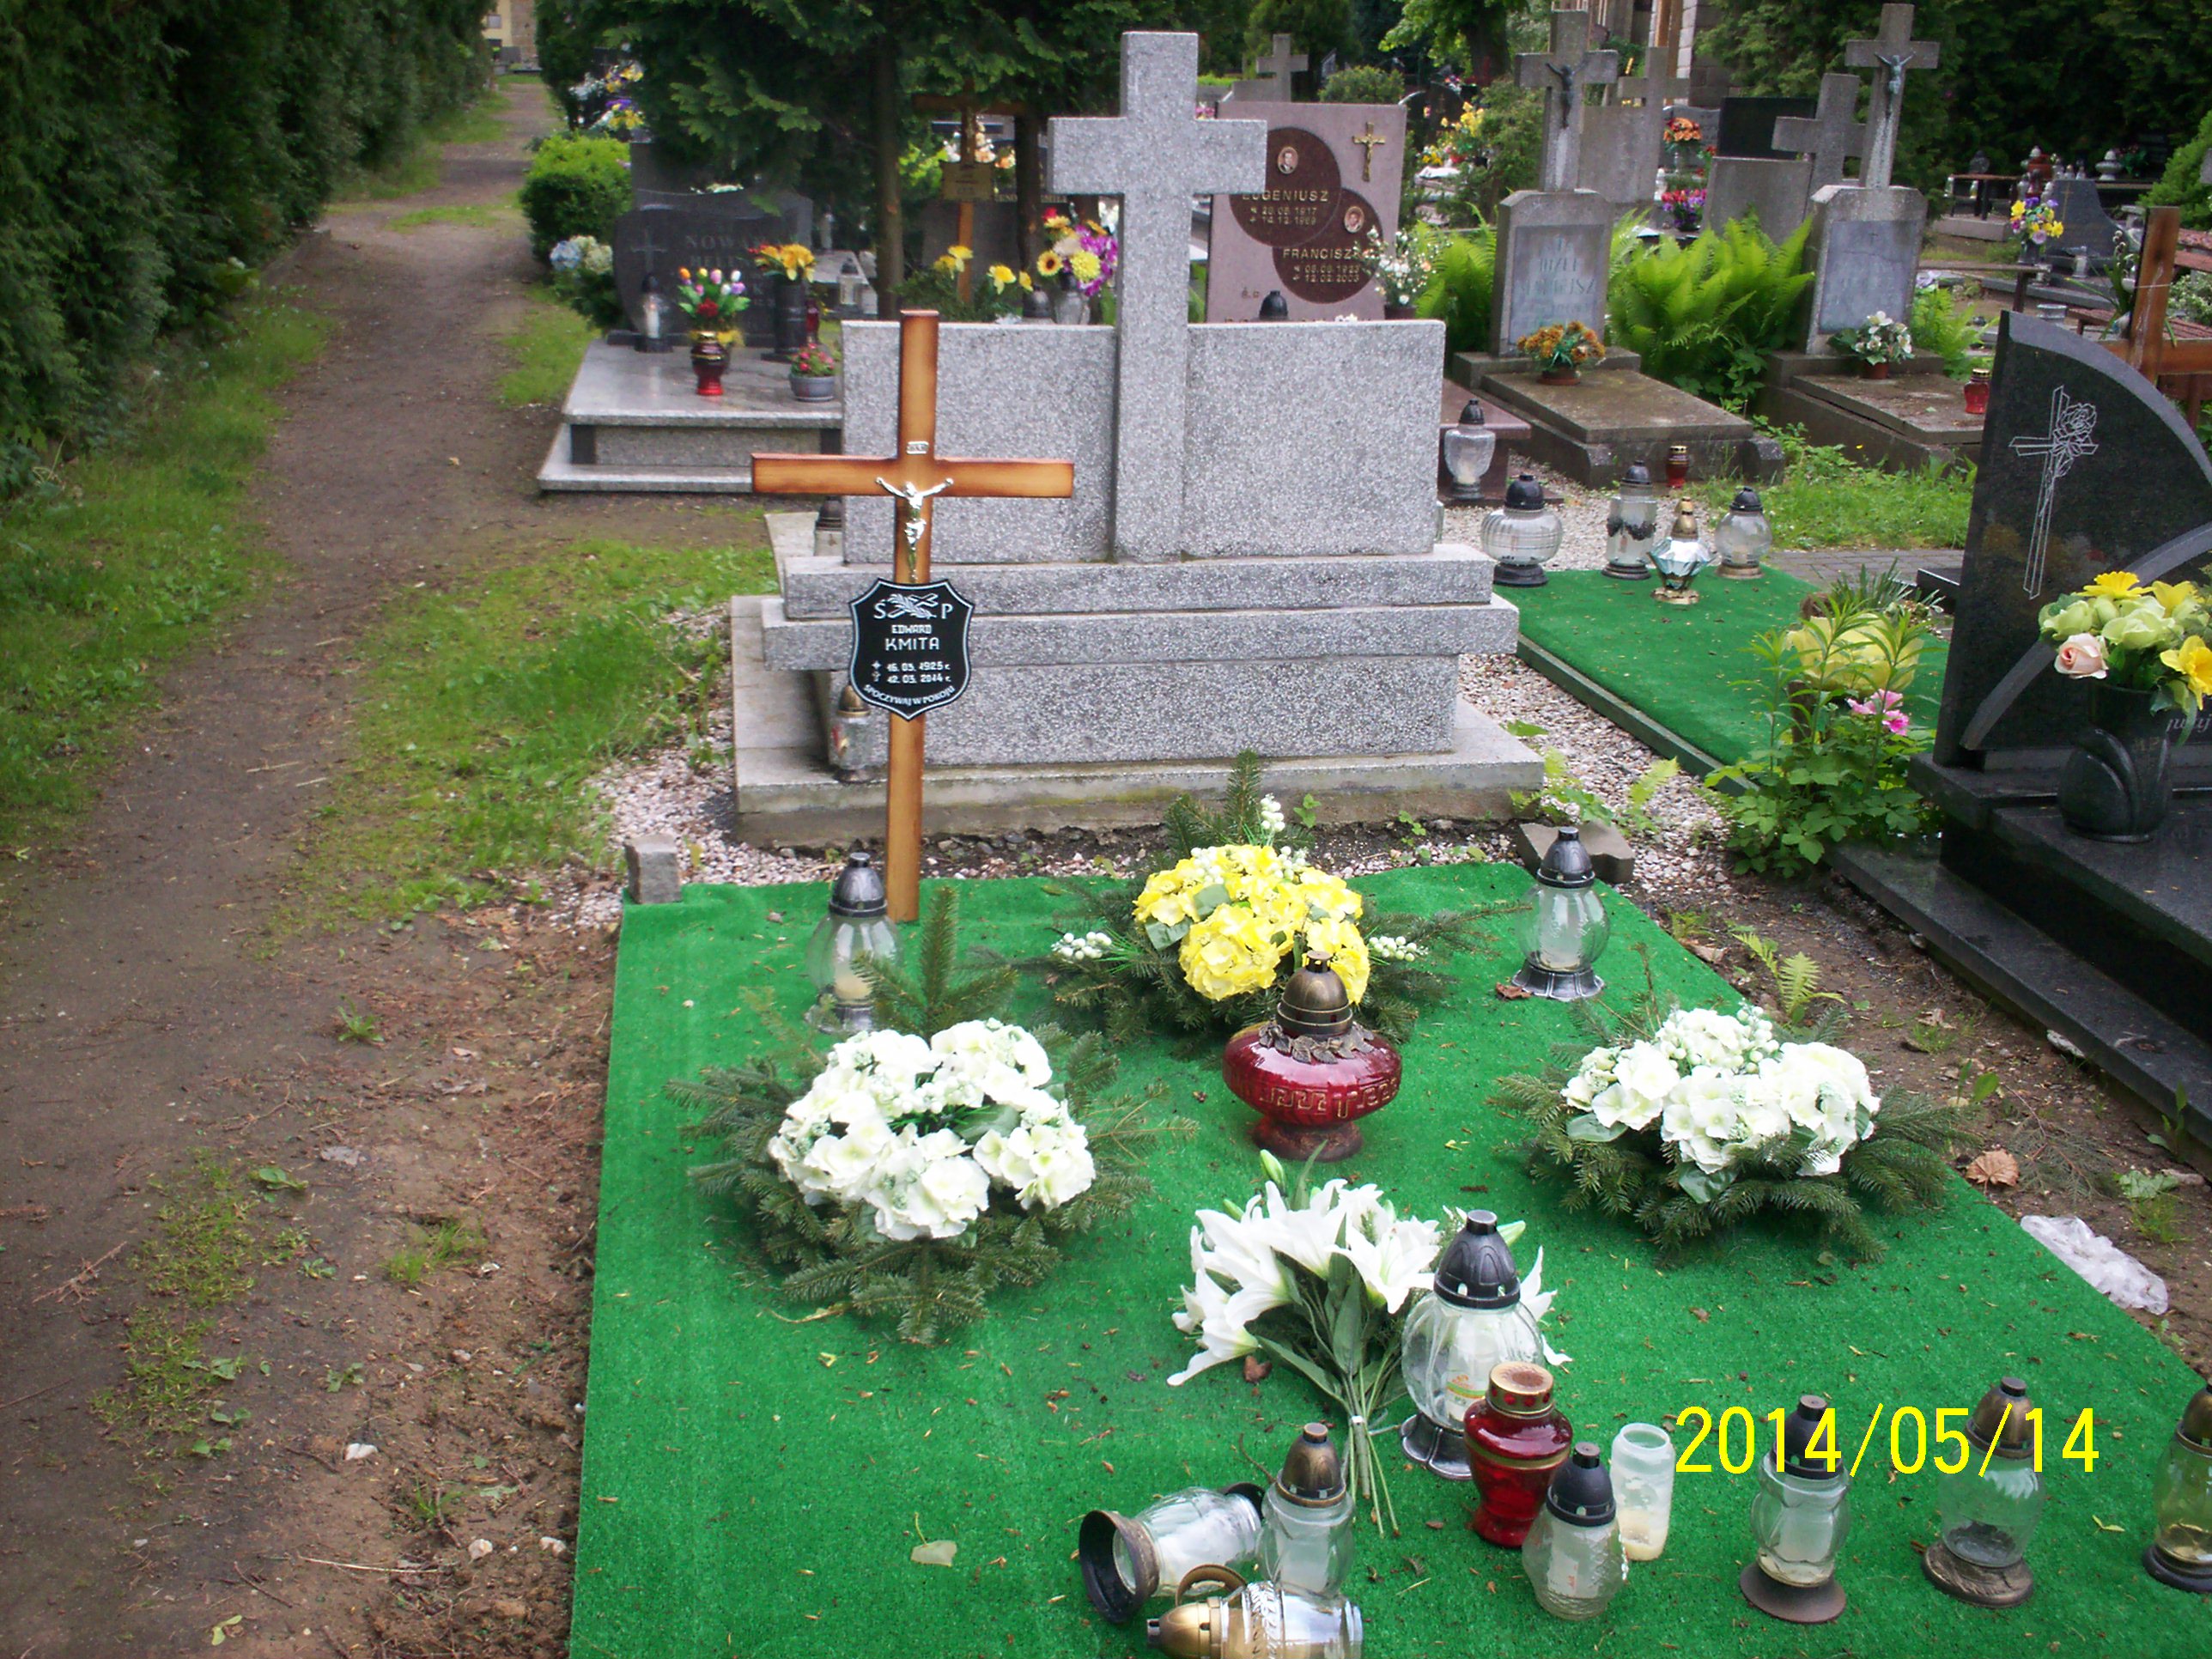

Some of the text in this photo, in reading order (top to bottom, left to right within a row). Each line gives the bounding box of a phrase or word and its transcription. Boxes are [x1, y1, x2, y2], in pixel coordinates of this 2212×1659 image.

[1283, 248, 1360, 260] FRANCISZ
[941, 603, 954, 619] P
[891, 624, 932, 635] EDWARD
[884, 637, 939, 651] KMITA
[919, 661, 944, 671] 1925
[920, 673, 943, 683] 2014
[863, 684, 956, 706] SPOCZYWAJ W POKOJU
